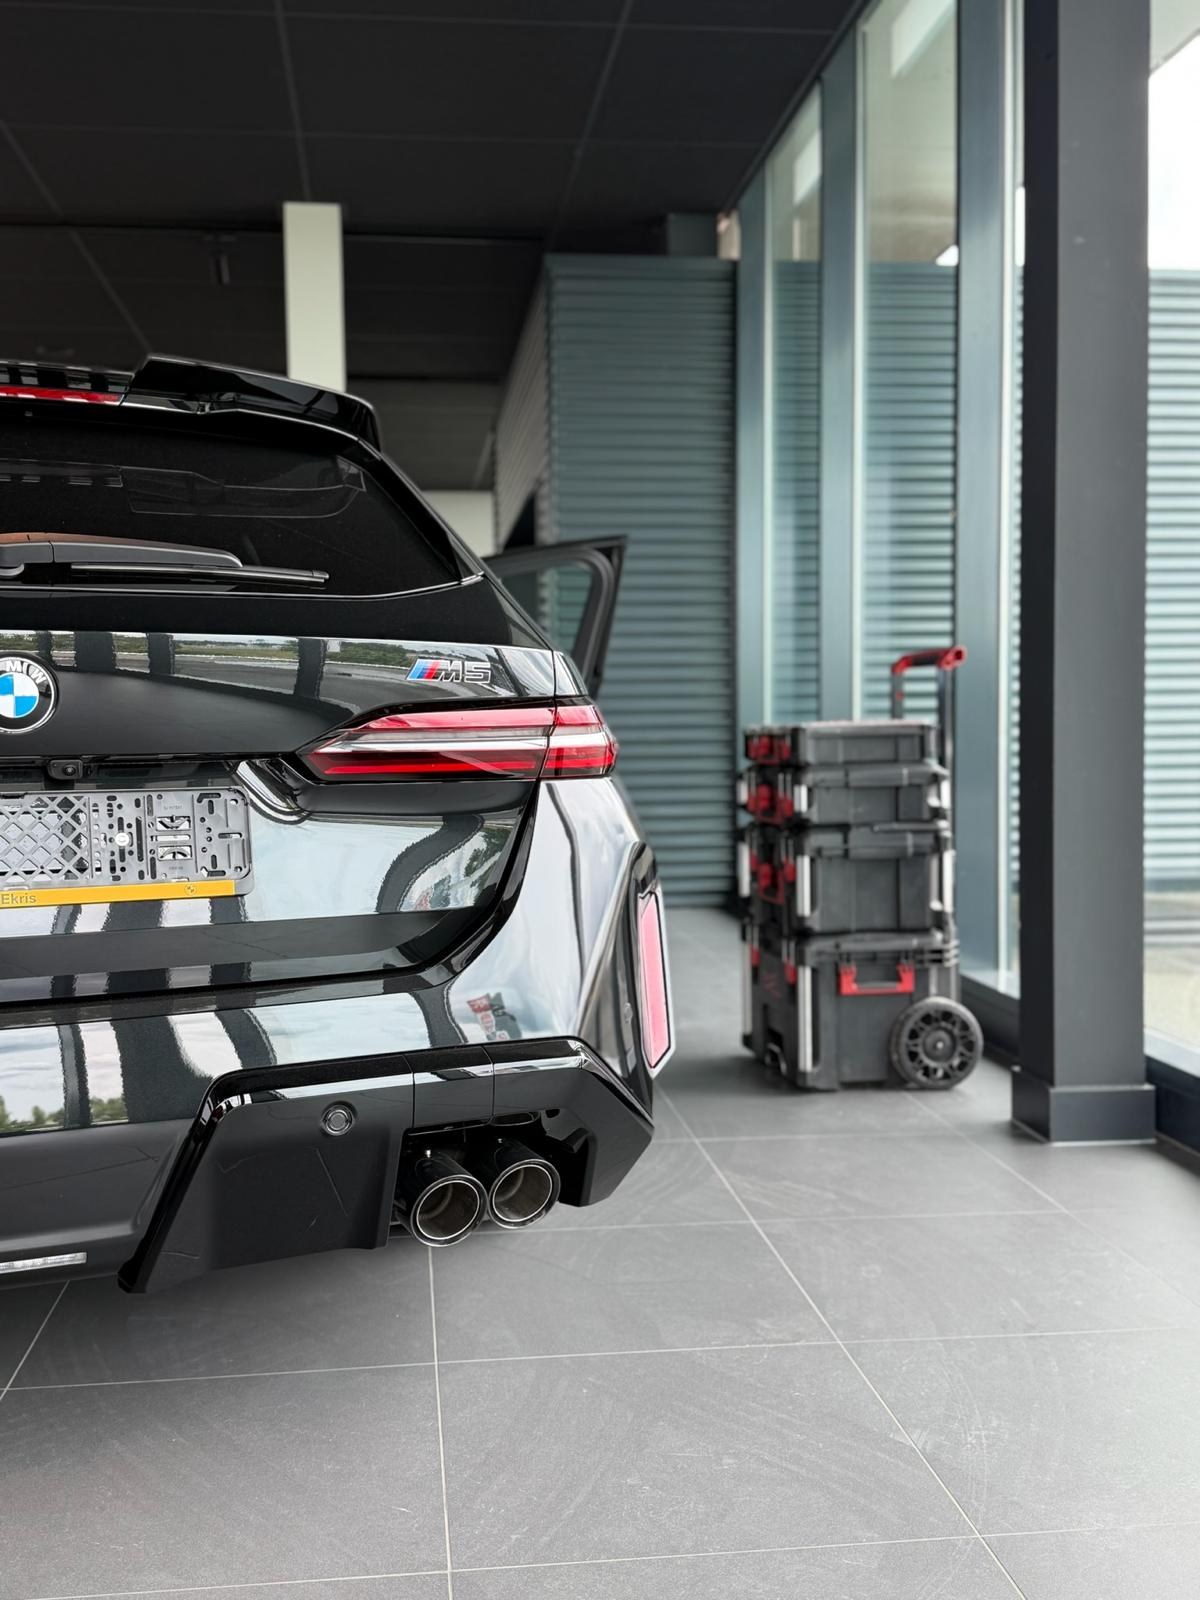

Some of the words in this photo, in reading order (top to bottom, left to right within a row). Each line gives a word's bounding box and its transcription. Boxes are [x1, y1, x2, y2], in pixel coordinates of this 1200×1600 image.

[4, 660, 48, 684] MW
[428, 659, 491, 683] M5
[1, 892, 37, 905] Ekris
